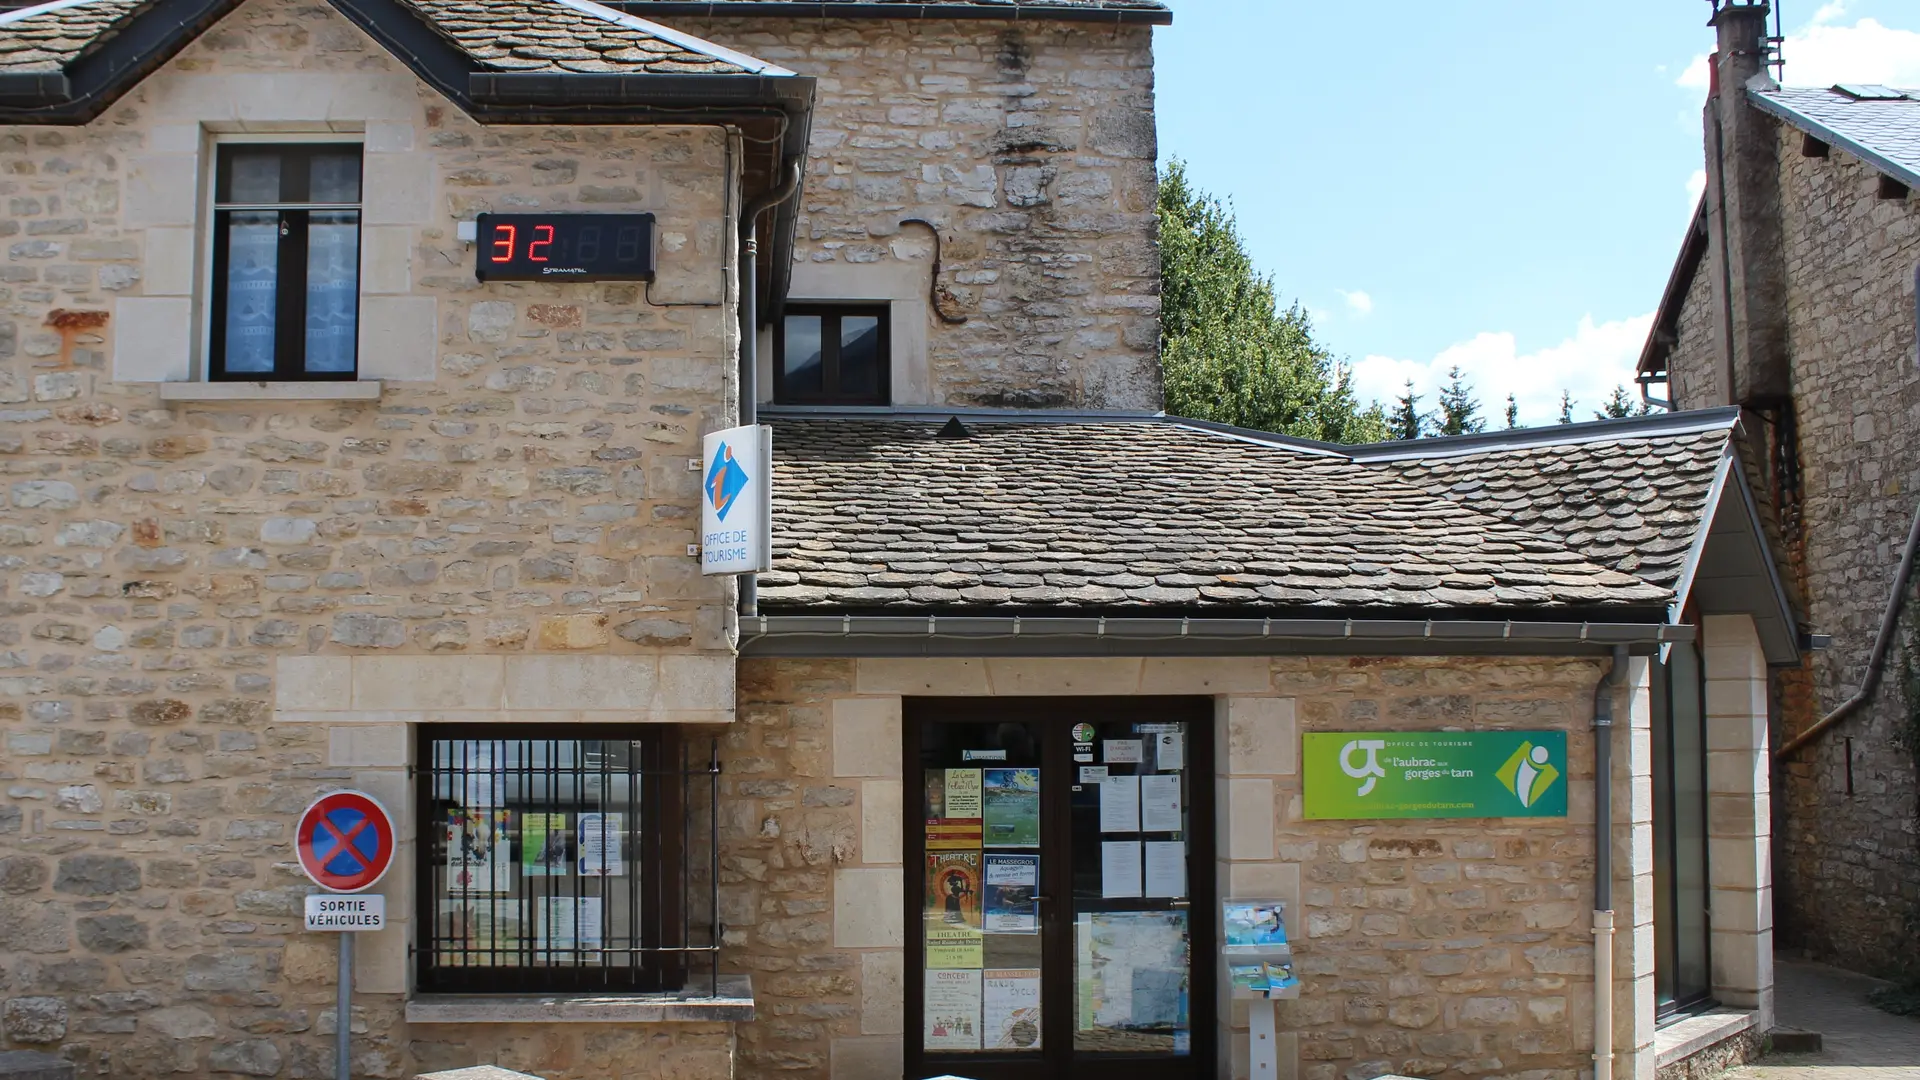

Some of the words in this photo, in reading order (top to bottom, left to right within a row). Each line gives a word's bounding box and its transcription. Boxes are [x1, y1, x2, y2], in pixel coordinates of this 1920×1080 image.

[491, 225, 554, 262] 32
[704, 531, 730, 547] OFFICE
[733, 530, 747, 542] DE
[704, 547, 747, 563] TOURISME
[1404, 769, 1441, 781] gorges
[1450, 768, 1473, 778] tarn
[319, 901, 366, 912] SORTIE
[308, 913, 380, 926] VÉHICULES
